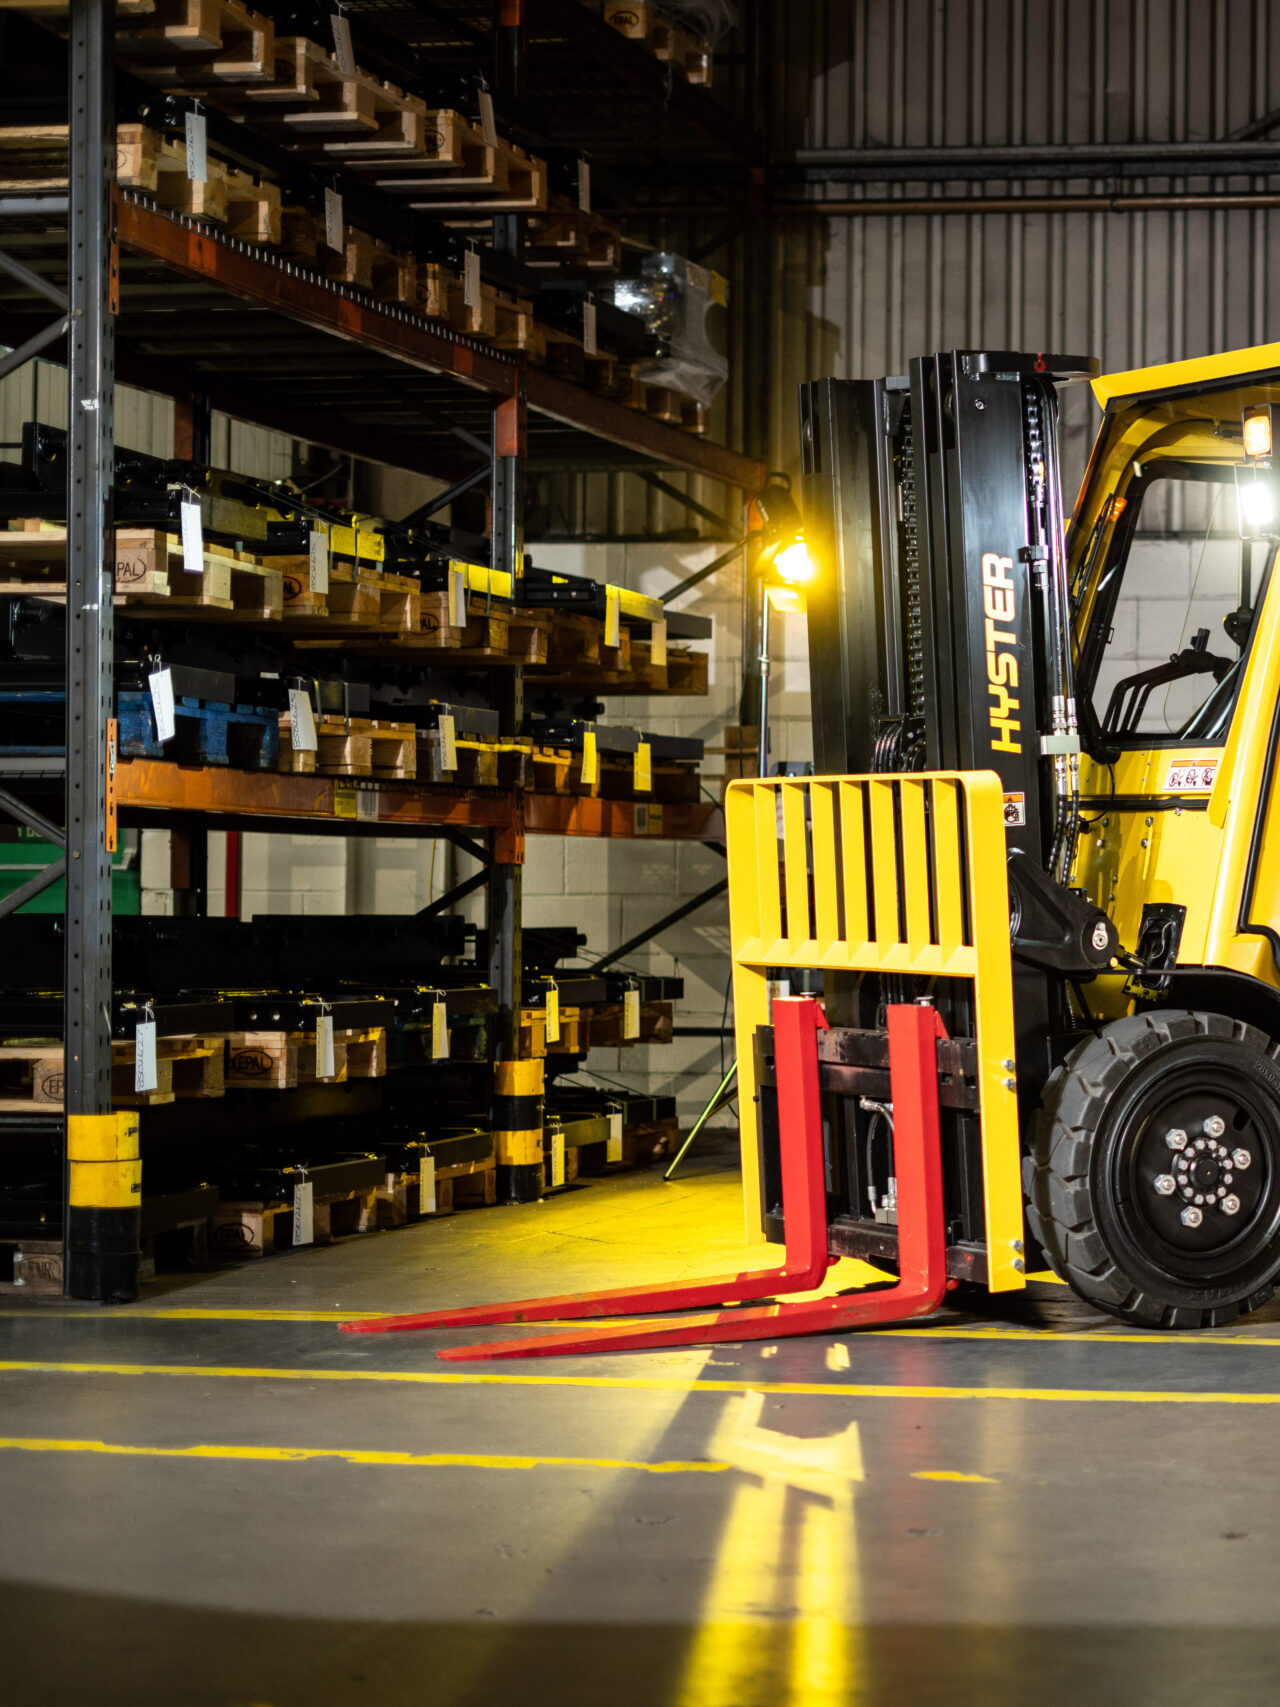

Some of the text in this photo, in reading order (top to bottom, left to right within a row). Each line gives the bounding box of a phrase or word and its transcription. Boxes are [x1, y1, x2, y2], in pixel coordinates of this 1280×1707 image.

[116, 561, 140, 577] PAL
[982, 553, 1022, 754] HYSTER
[237, 1055, 265, 1070] EPAL
[49, 1079, 64, 1095] EP
